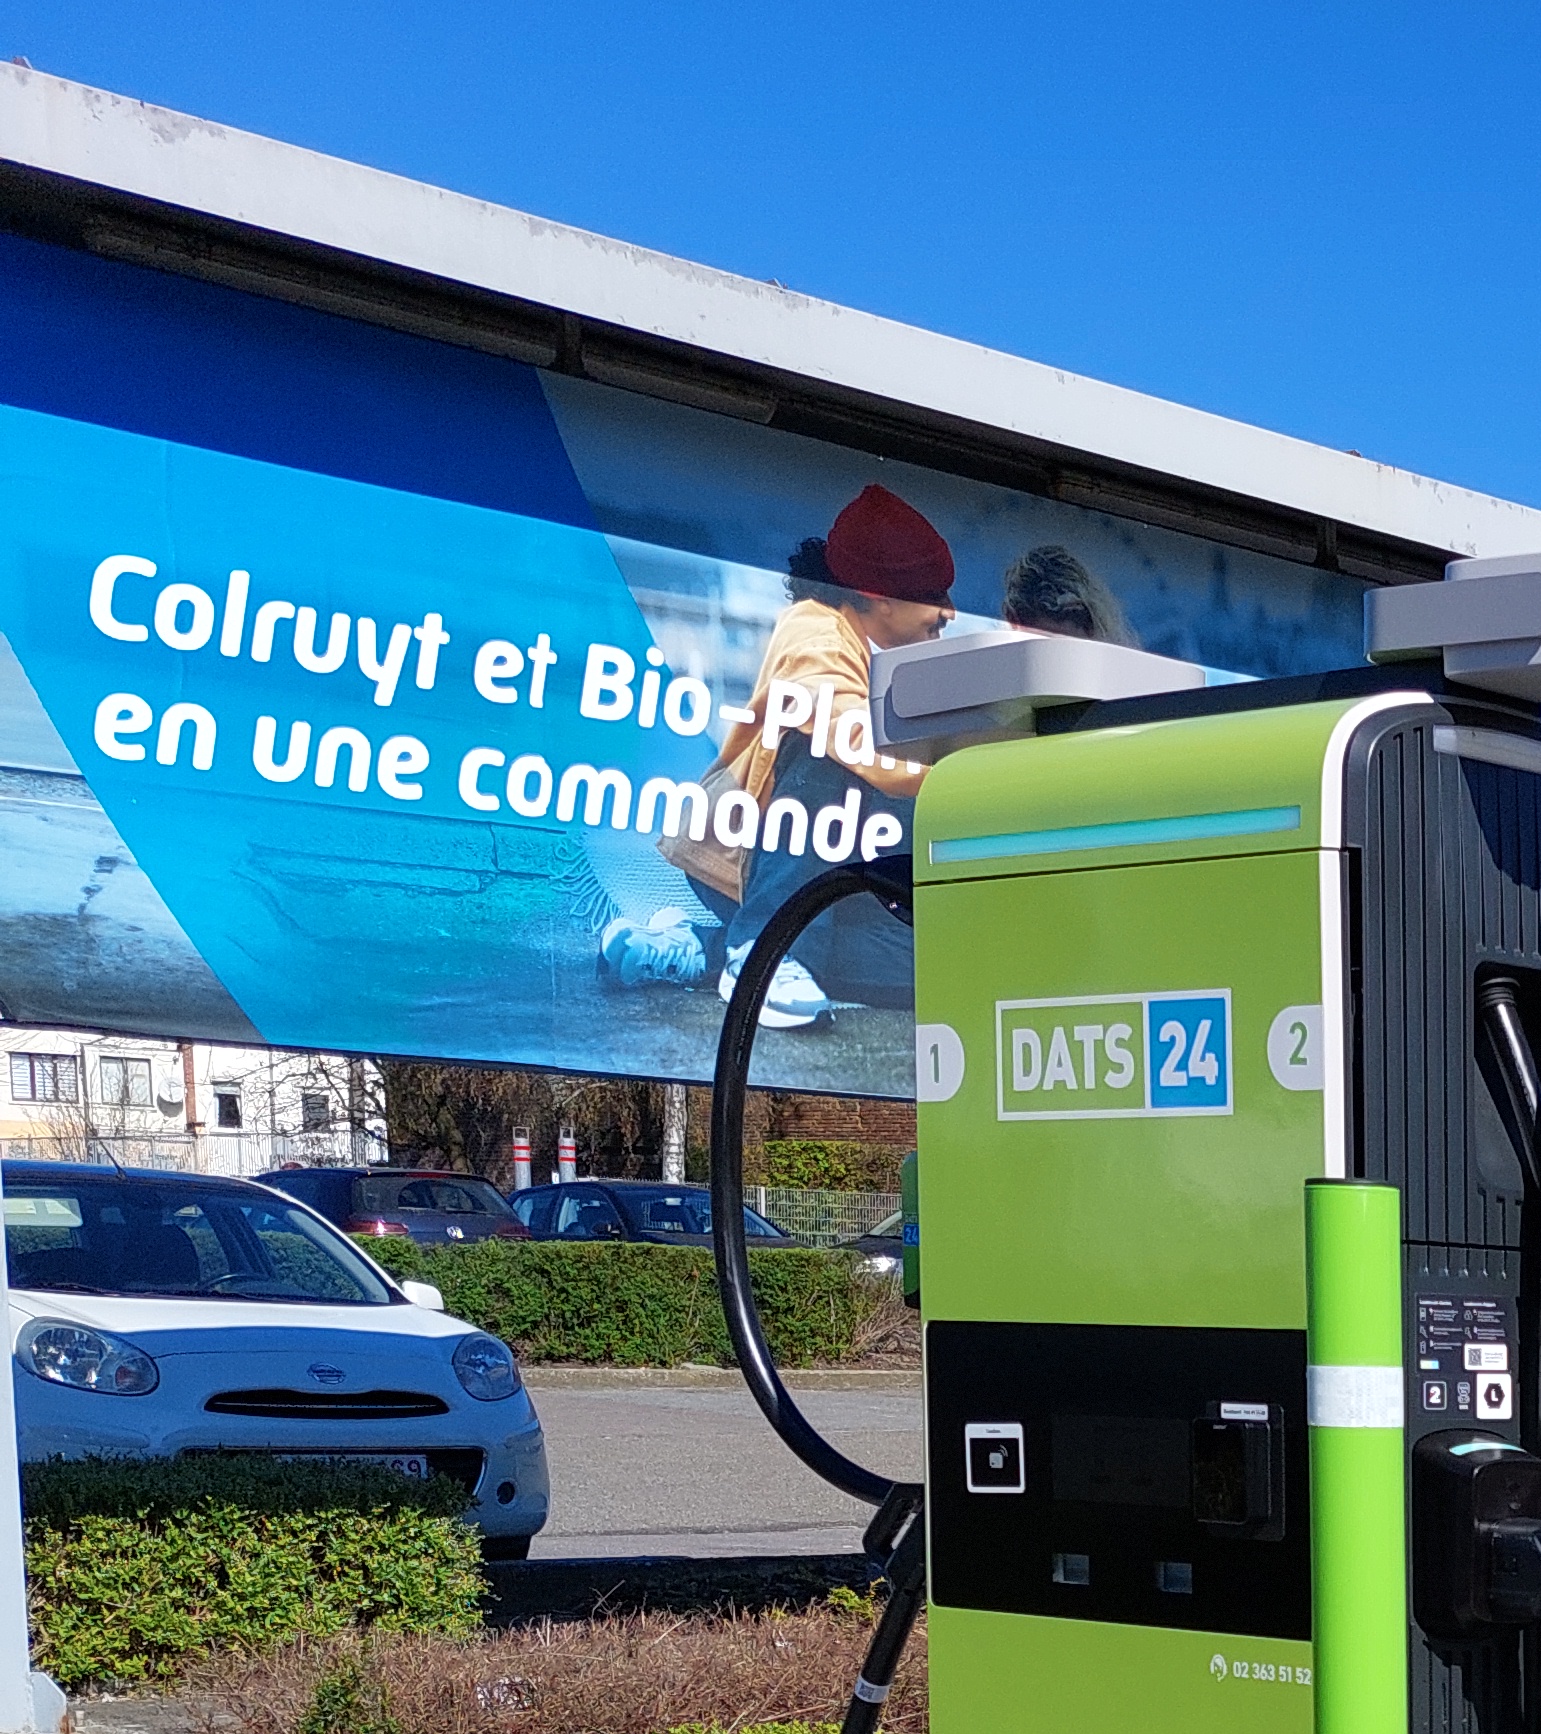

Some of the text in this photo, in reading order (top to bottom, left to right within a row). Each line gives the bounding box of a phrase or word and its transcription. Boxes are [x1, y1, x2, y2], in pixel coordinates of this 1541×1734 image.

[89, 554, 922, 775] Colruyt et Bio-Pla
[93, 692, 904, 864] en une commande
[929, 1042, 940, 1084] 1
[1011, 1019, 1219, 1092] DATS 24
[1288, 1020, 1309, 1067] 2
[1429, 1385, 1441, 1404] 2
[1491, 1389, 1499, 1402] L
[1233, 1661, 1312, 1686] 02 363 51 52
